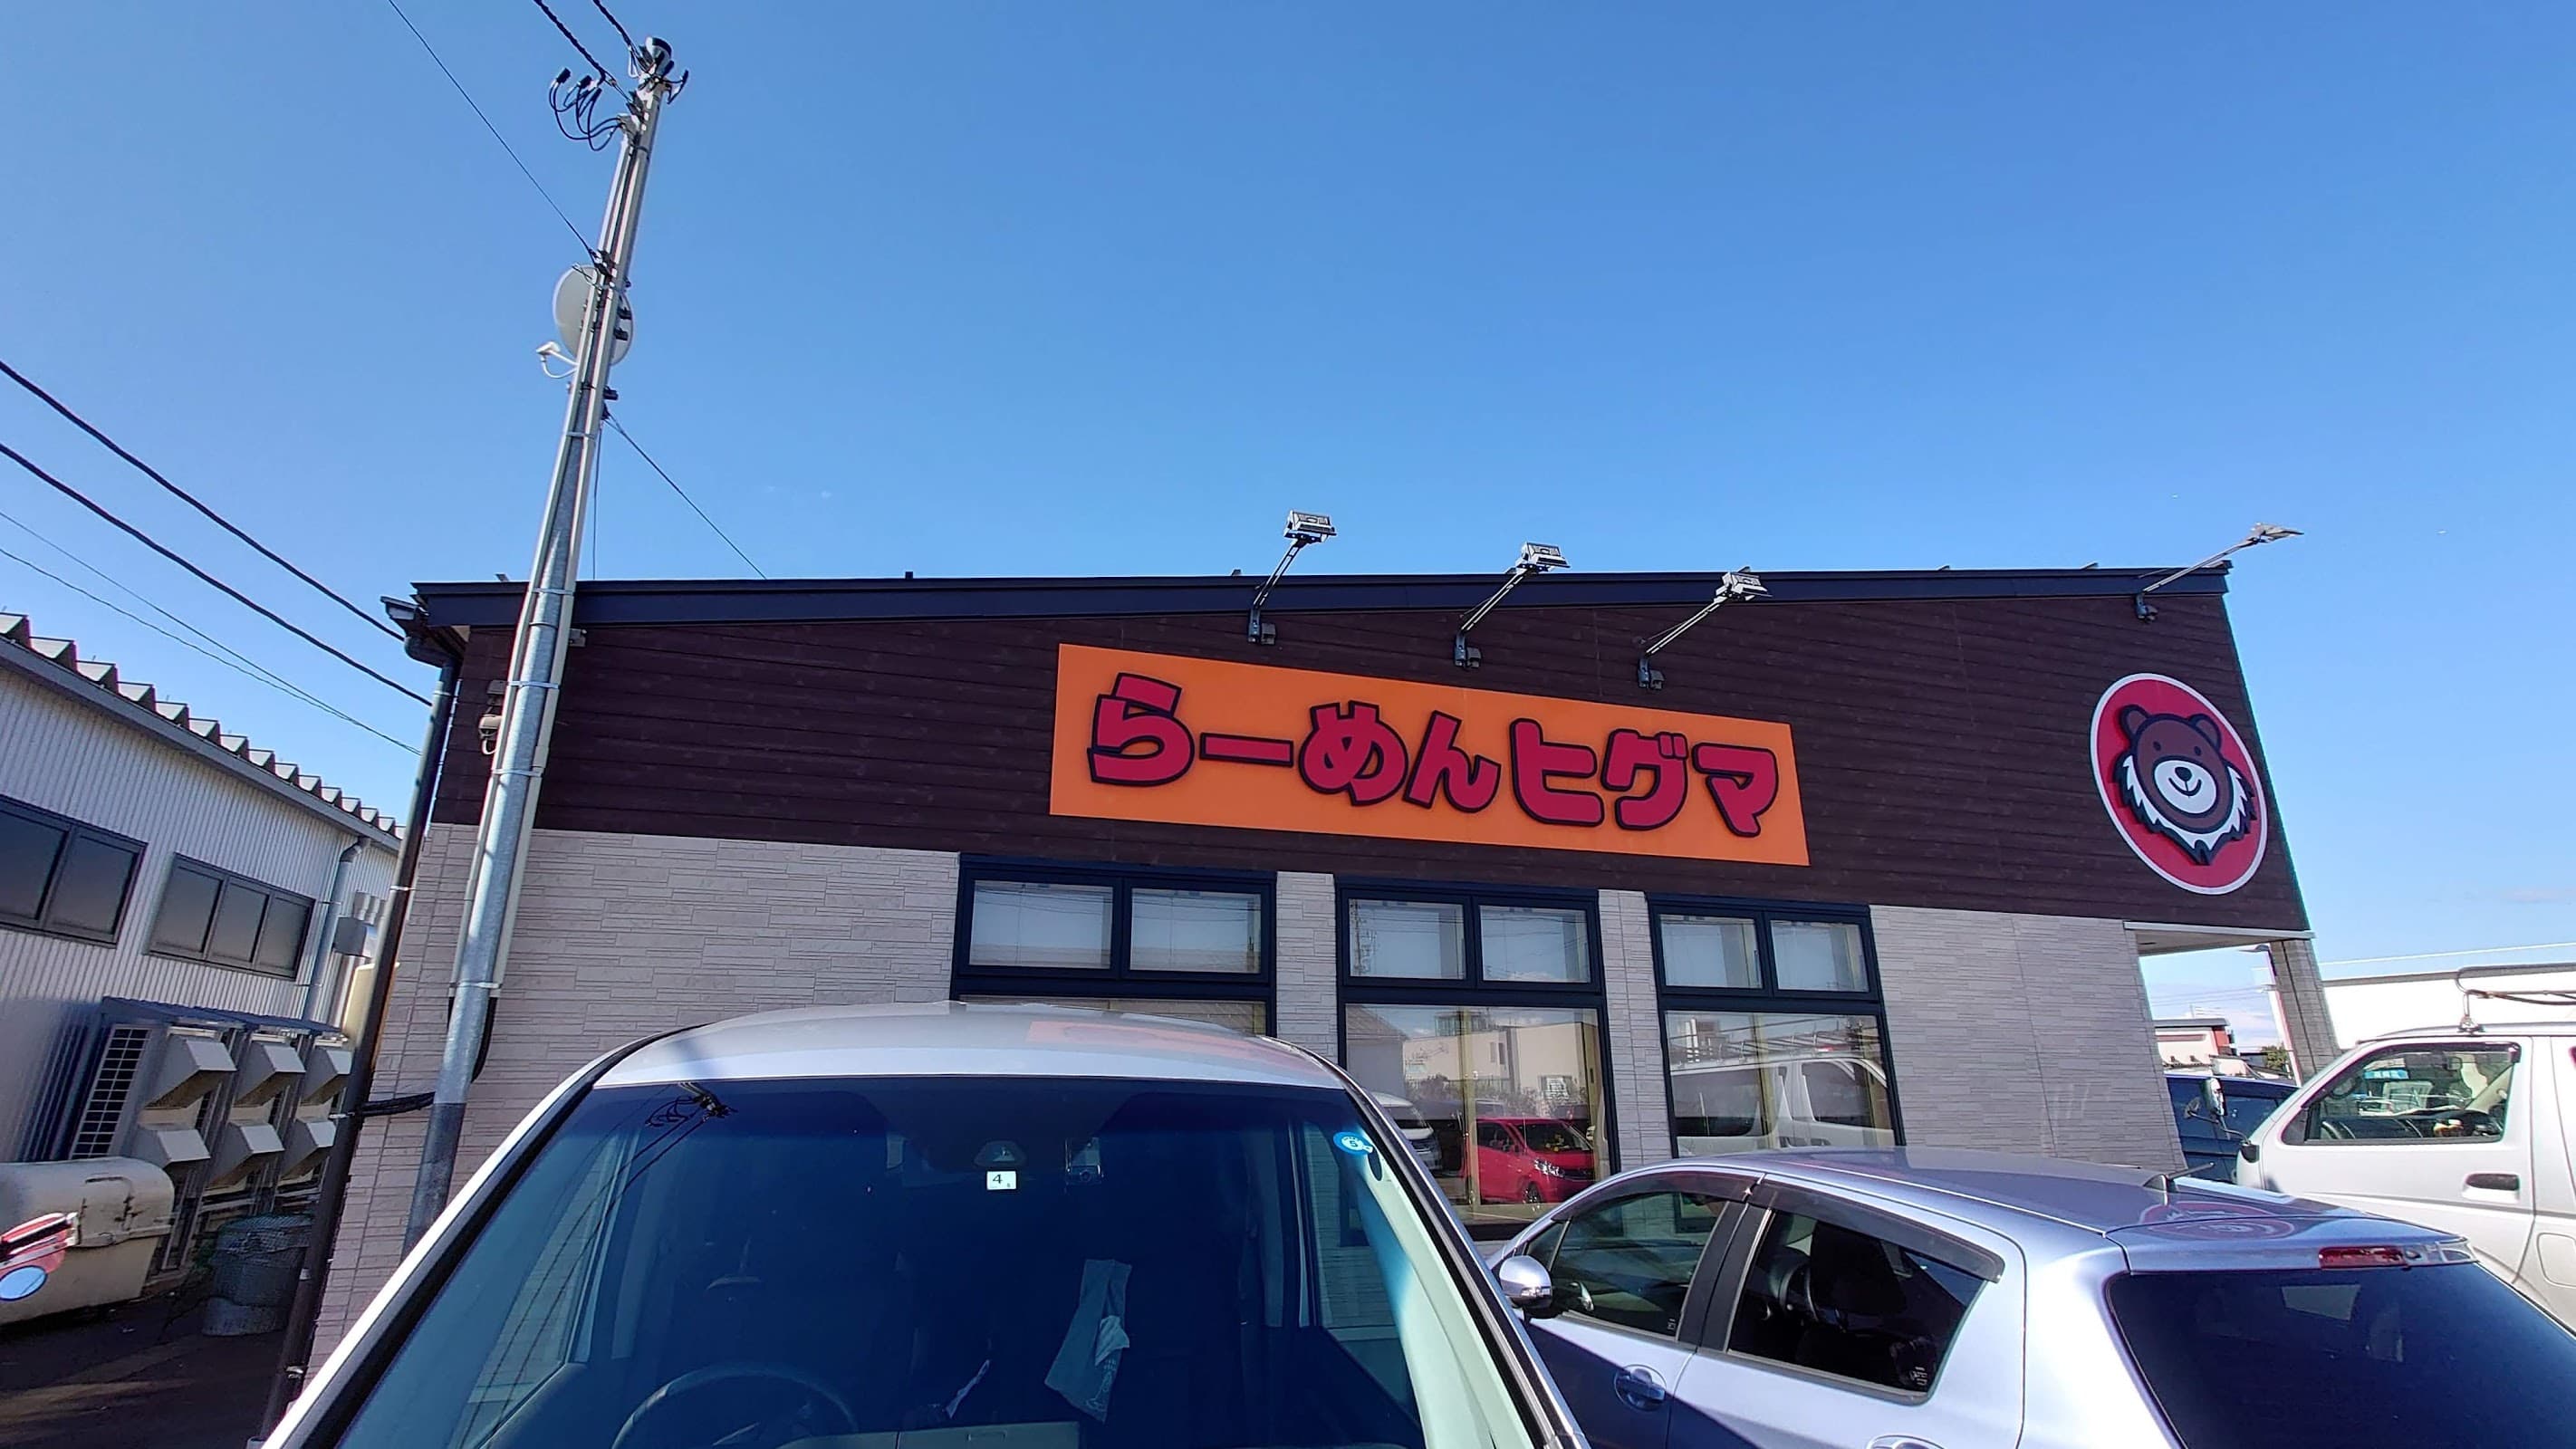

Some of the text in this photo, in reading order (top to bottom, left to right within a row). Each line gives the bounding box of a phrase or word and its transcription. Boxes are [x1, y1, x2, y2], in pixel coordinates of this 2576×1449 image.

[1088, 672, 1779, 837] らーめんヒグマ
[992, 1174, 1003, 1184] 4
